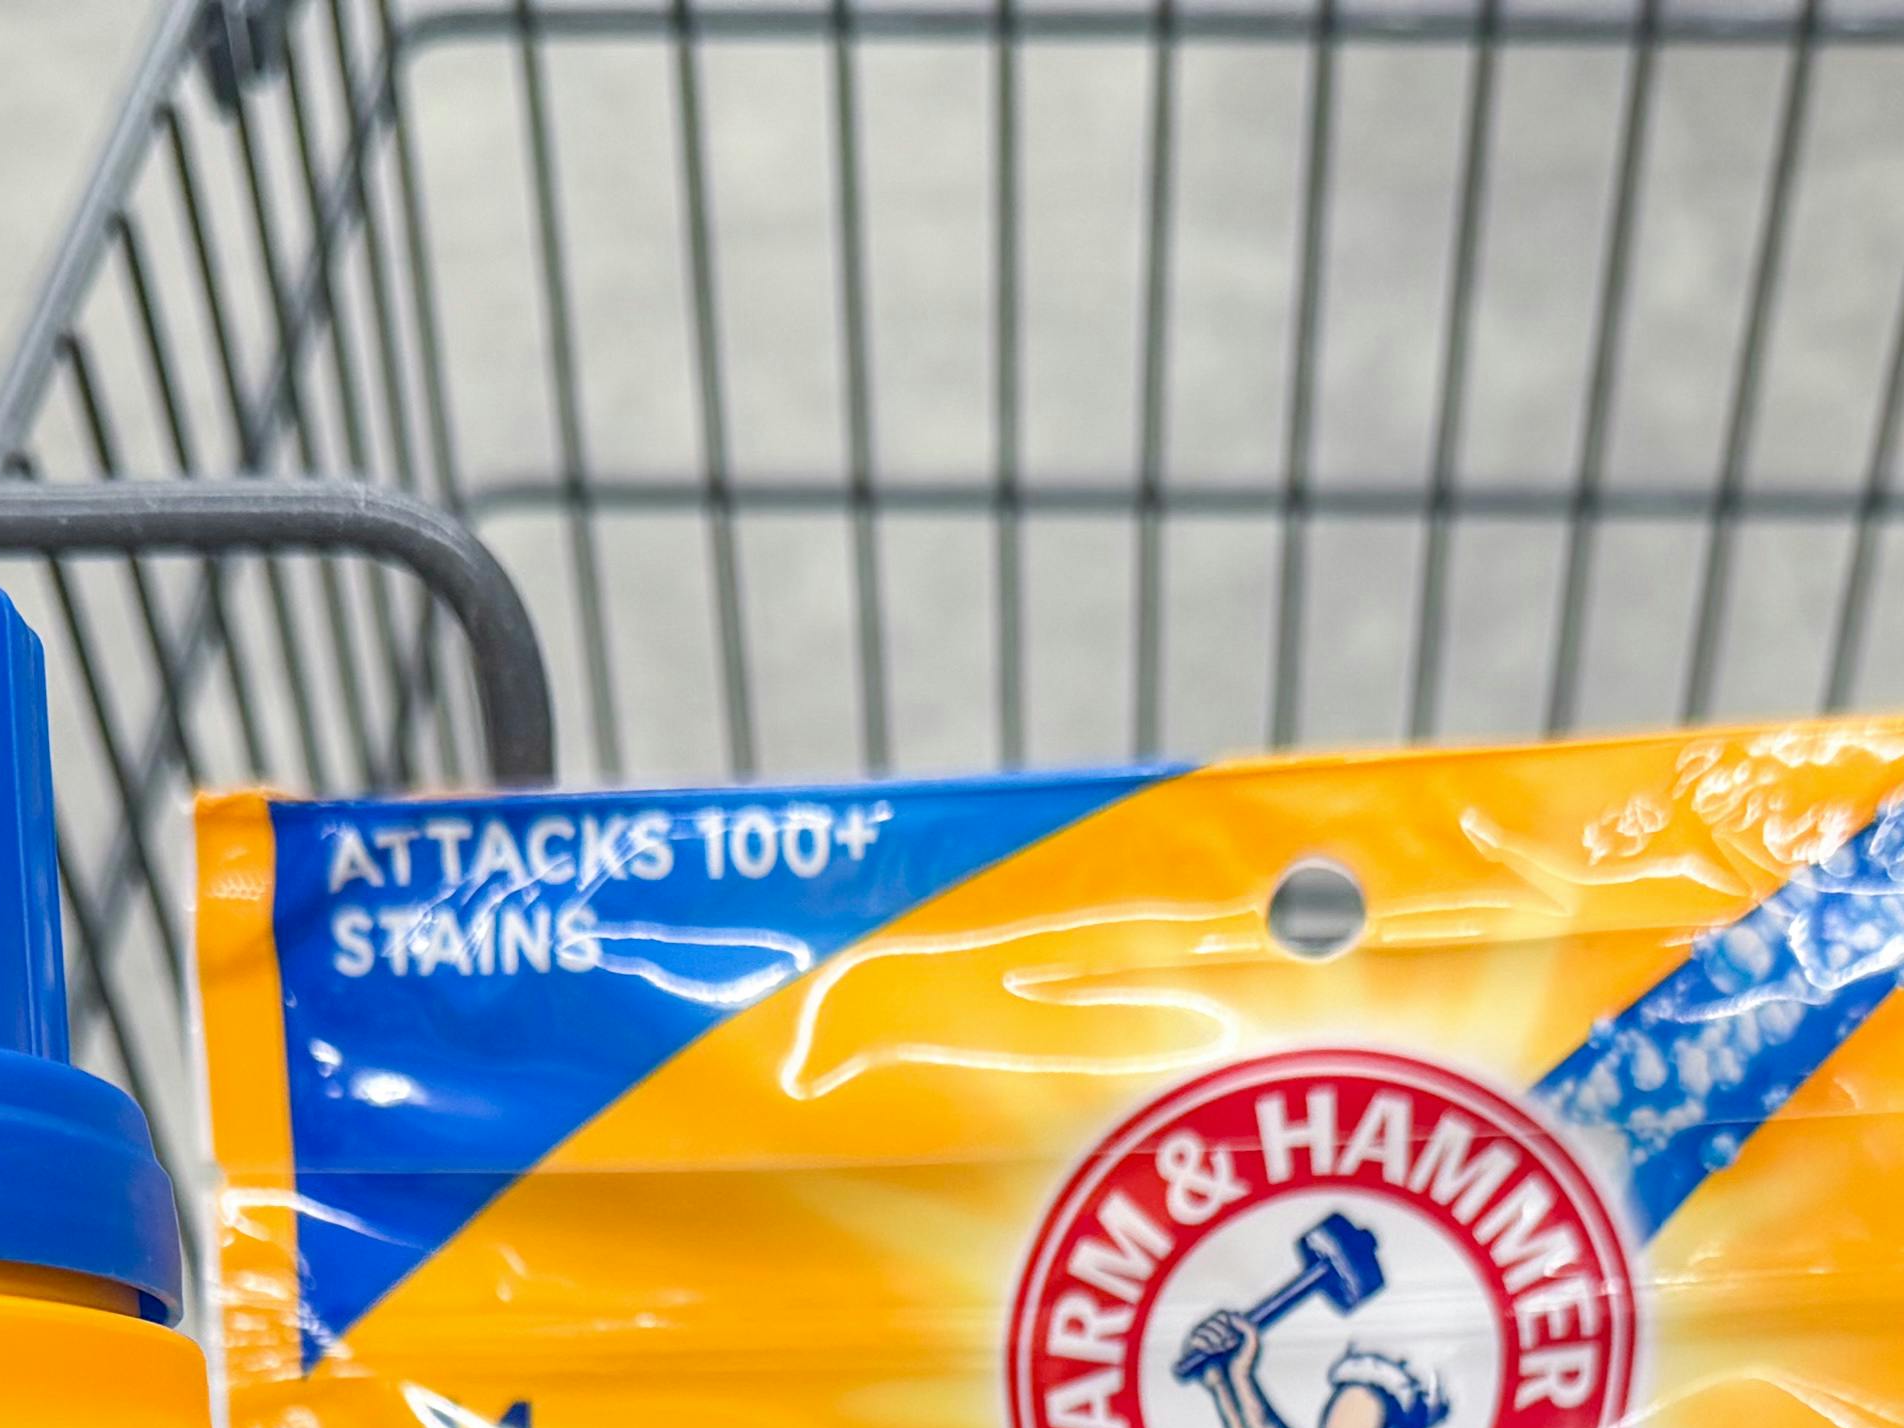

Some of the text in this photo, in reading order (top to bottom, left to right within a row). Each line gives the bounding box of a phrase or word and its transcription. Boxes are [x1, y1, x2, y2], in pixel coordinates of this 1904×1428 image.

[328, 804, 880, 893] ATTACKS 100+
[330, 905, 604, 978] STAINS
[1154, 1129, 1251, 1226] &
[1255, 1085, 1597, 1413] HAMMER
